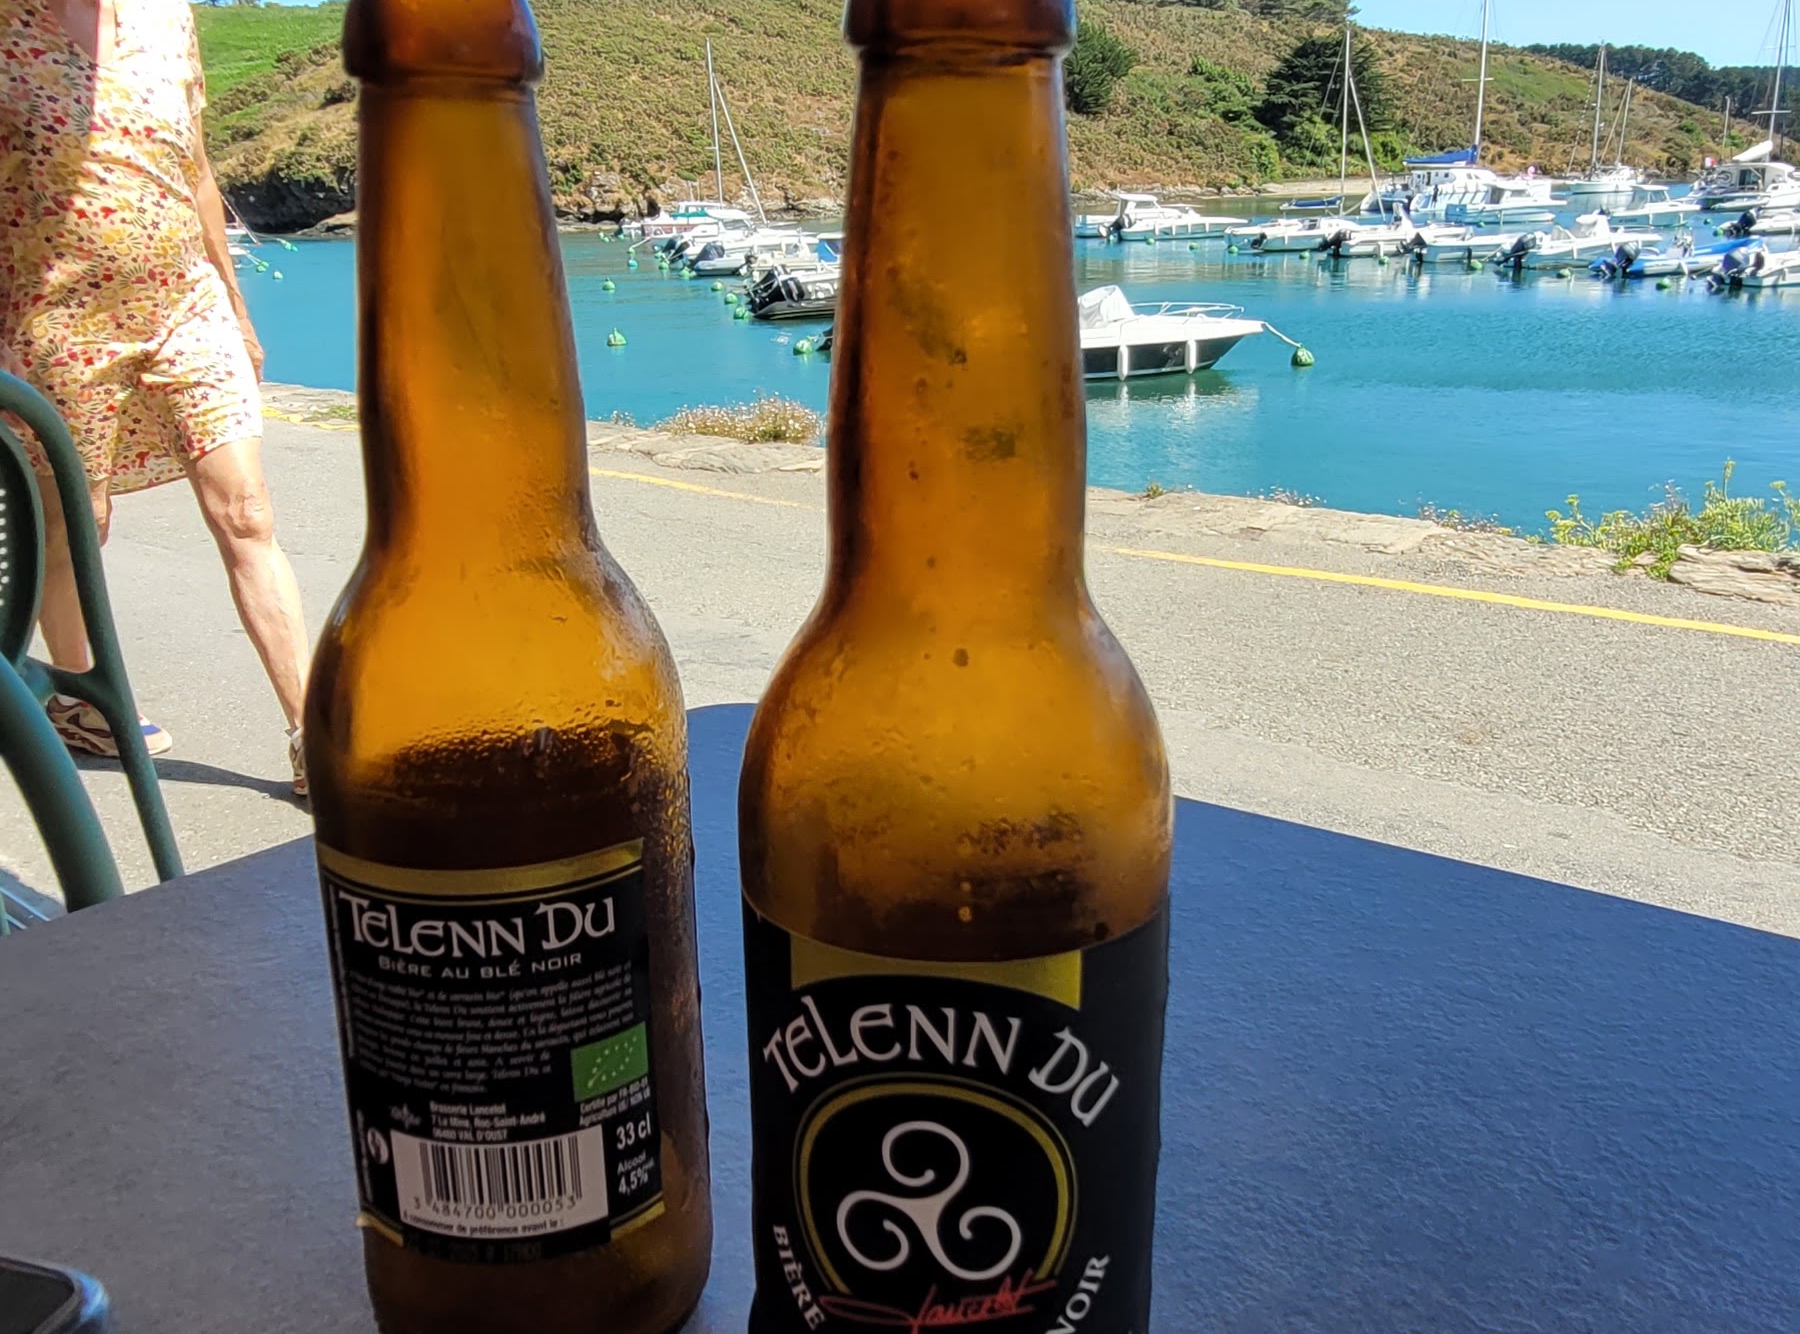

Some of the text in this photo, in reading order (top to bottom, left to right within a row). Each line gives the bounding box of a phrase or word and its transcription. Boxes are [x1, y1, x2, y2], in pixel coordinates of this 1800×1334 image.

[441, 967, 469, 979] AU
[480, 959, 521, 979] BLÉ
[531, 952, 582, 974] NOIR
[763, 995, 1120, 1127] TELENN DU
[616, 1111, 652, 1150] 33 cl
[617, 1150, 647, 1175] Alcool
[772, 1224, 826, 1331] BIÈRE
